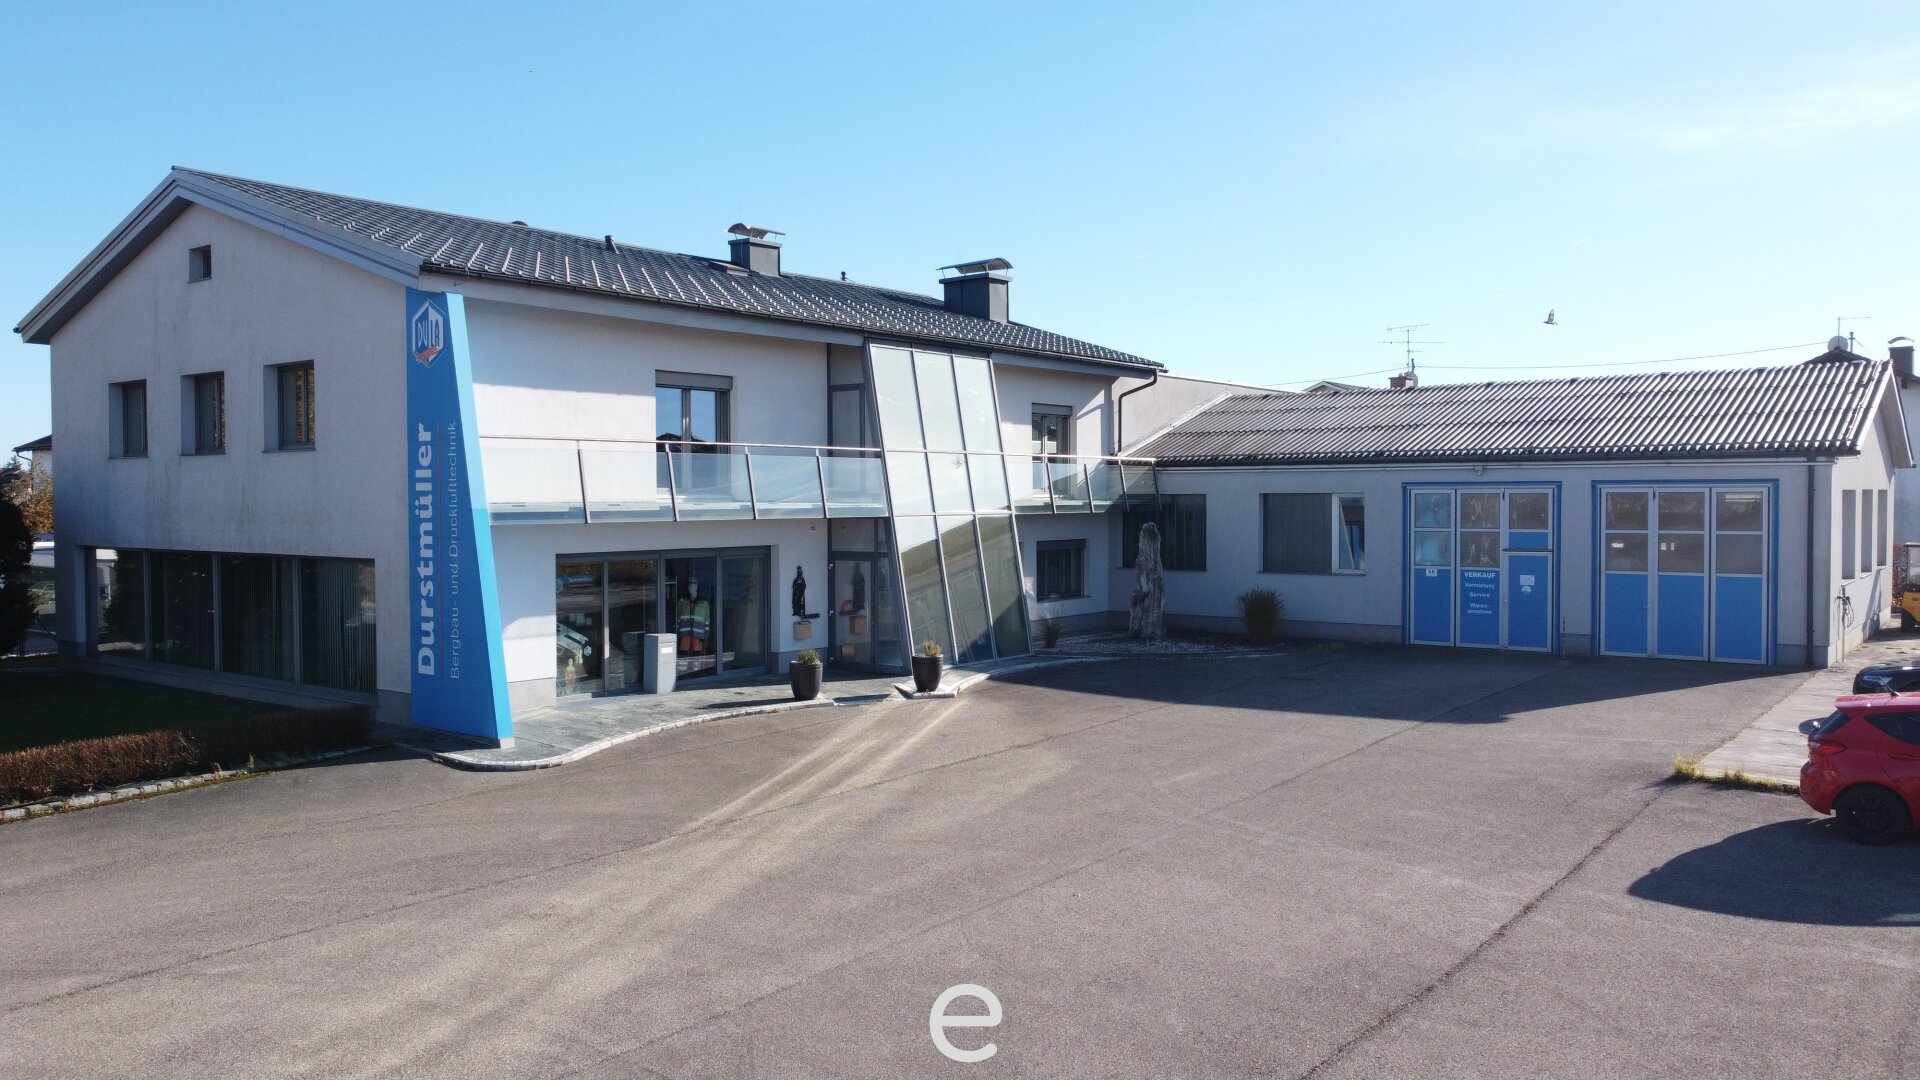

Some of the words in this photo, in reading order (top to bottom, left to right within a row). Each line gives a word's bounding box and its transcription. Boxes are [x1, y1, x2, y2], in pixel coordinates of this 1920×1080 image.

[447, 421, 459, 558] Drucklufttechnik
[415, 422, 435, 676] Durstmüller
[449, 563, 459, 595] und
[450, 600, 462, 680] Bergbau-
